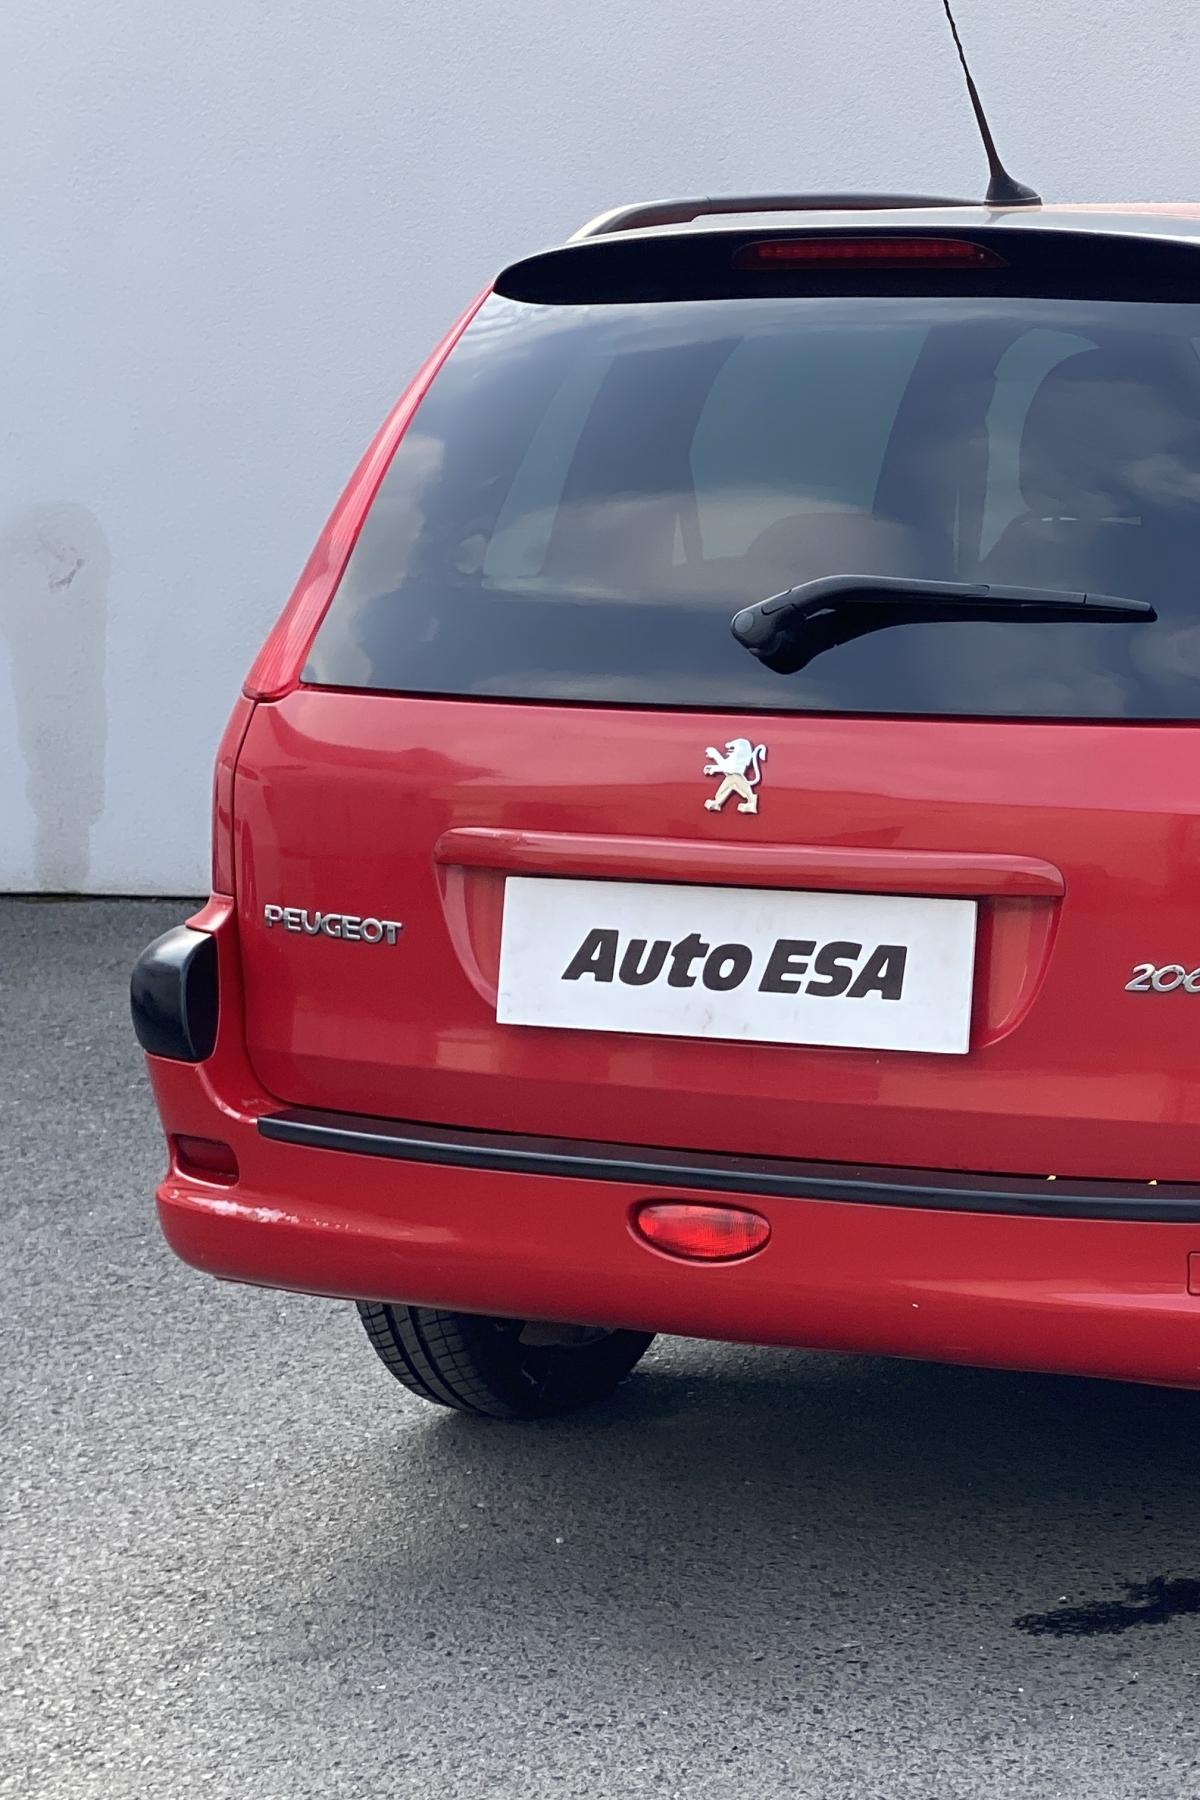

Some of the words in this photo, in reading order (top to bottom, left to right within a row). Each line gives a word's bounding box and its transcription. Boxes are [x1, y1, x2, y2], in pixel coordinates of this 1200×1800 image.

[264, 904, 402, 944] PEUGEOT
[561, 928, 753, 992] Auto
[758, 938, 908, 1001] ESA
